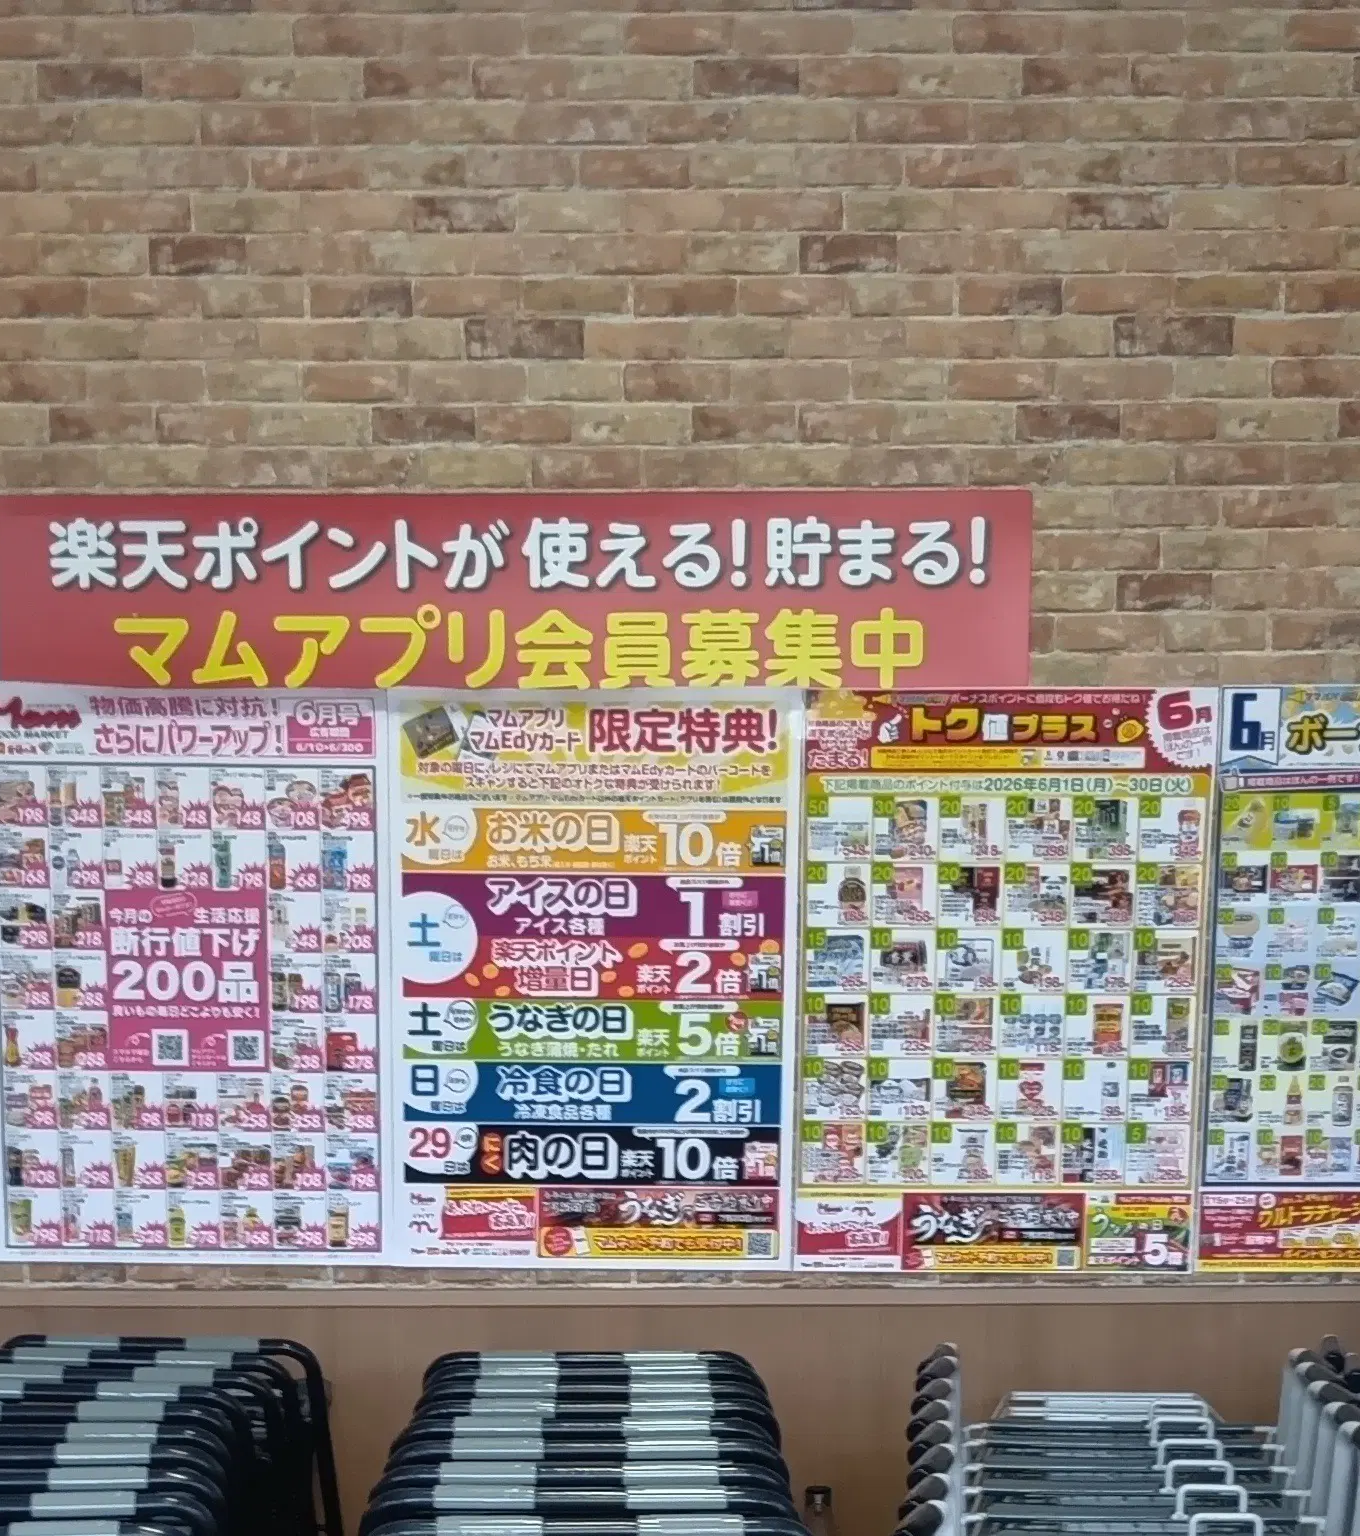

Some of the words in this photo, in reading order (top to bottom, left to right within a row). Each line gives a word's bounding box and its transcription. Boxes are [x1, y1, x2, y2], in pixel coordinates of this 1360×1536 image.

[114, 604, 924, 690] マムアプリ会員募集中
[293, 701, 362, 725] 6月号
[488, 709, 565, 727] マムアプリ
[1157, 692, 1213, 730] 6月
[1229, 693, 1275, 751] 6月
[94, 723, 283, 755] さらにパワーアップ！
[470, 730, 581, 753] マムEdyカード
[588, 708, 778, 754] 限定特典！
[18, 808, 43, 824] 198
[808, 800, 827, 814] 50
[875, 800, 893, 814] 30
[940, 800, 961, 814] 20
[1140, 801, 1159, 815] 20
[406, 811, 438, 846] 水
[488, 812, 616, 847] お米の日
[624, 835, 657, 853] 楽天
[662, 823, 742, 867] 10倍
[807, 867, 826, 881] 20
[873, 867, 892, 881] 20
[487, 879, 633, 911] アイスの日
[407, 914, 442, 947] 土
[515, 918, 605, 935] アイス各種
[808, 932, 825, 946] 15
[873, 932, 890, 946] 10
[110, 928, 261, 957] 断行値下げ
[492, 940, 621, 966] 楽天ポイント
[112, 961, 259, 1003] 200品
[636, 965, 671, 983] 楽天
[675, 952, 741, 995] 2倍
[407, 1003, 442, 1037] 土
[488, 1004, 627, 1035] うなぎの日
[636, 1030, 670, 1046] 楽天
[676, 1014, 740, 1057] 5倍
[412, 1065, 438, 1096] 日
[497, 1066, 625, 1098] 冷食の日
[514, 1104, 612, 1120] 冷凍食品各種
[674, 1080, 761, 1123] 2割引
[409, 1128, 451, 1159] 29
[506, 1133, 610, 1172] 肉の日
[620, 1150, 654, 1167] 楽天
[657, 1139, 738, 1179] 10倍
